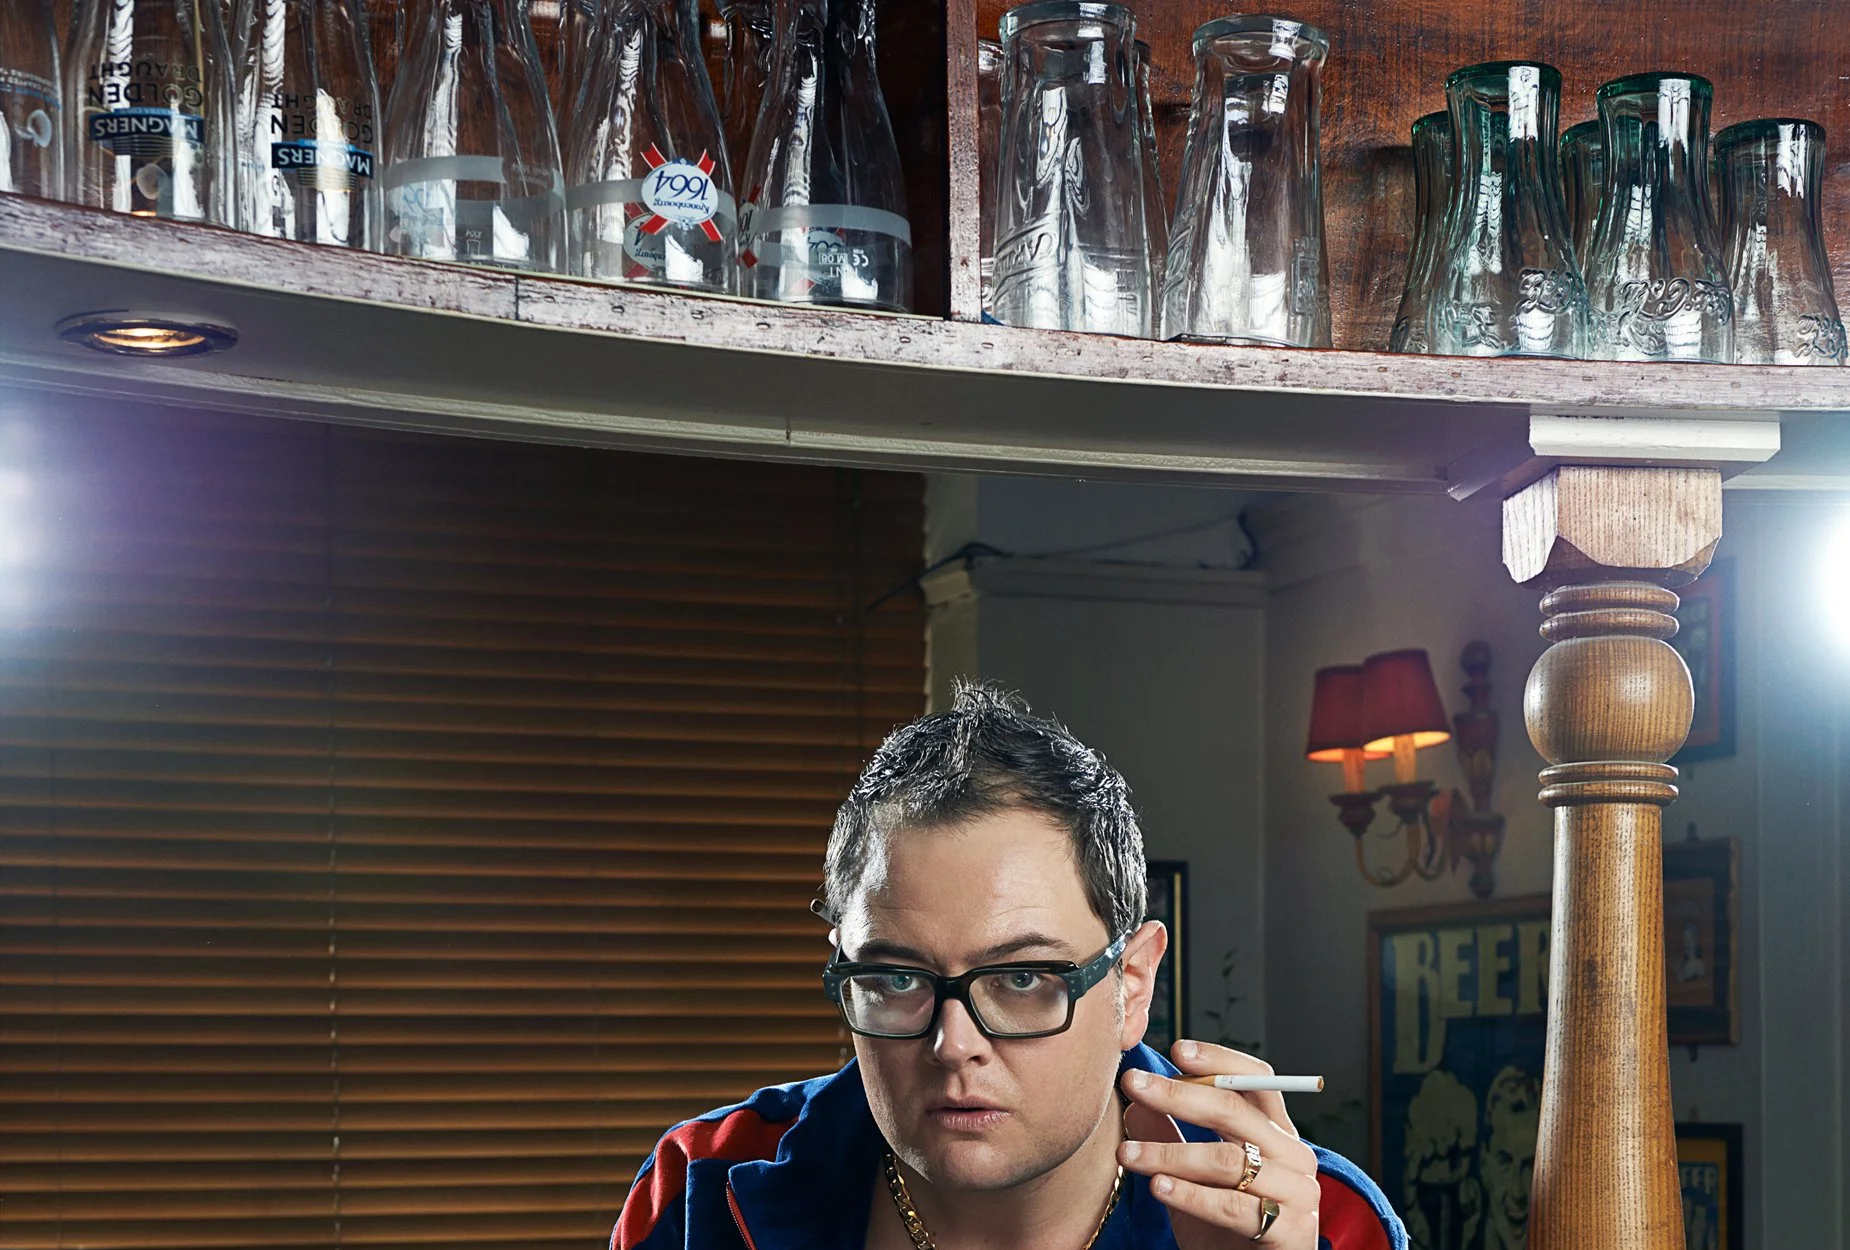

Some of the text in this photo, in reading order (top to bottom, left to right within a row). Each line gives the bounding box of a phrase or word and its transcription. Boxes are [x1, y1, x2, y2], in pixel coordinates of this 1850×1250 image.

[90, 61, 199, 83] DRAUGHT
[87, 82, 203, 107] GOLDEN
[271, 94, 372, 119] DRAGHT
[94, 116, 198, 138] MAGNERS
[271, 114, 373, 145] GODEN
[276, 147, 371, 174] MAGNERS
[652, 170, 709, 201] 1664
[652, 197, 711, 214] Kronenbourg
[1392, 920, 1552, 1074] BEER
[1681, 1166, 1717, 1195] EER
